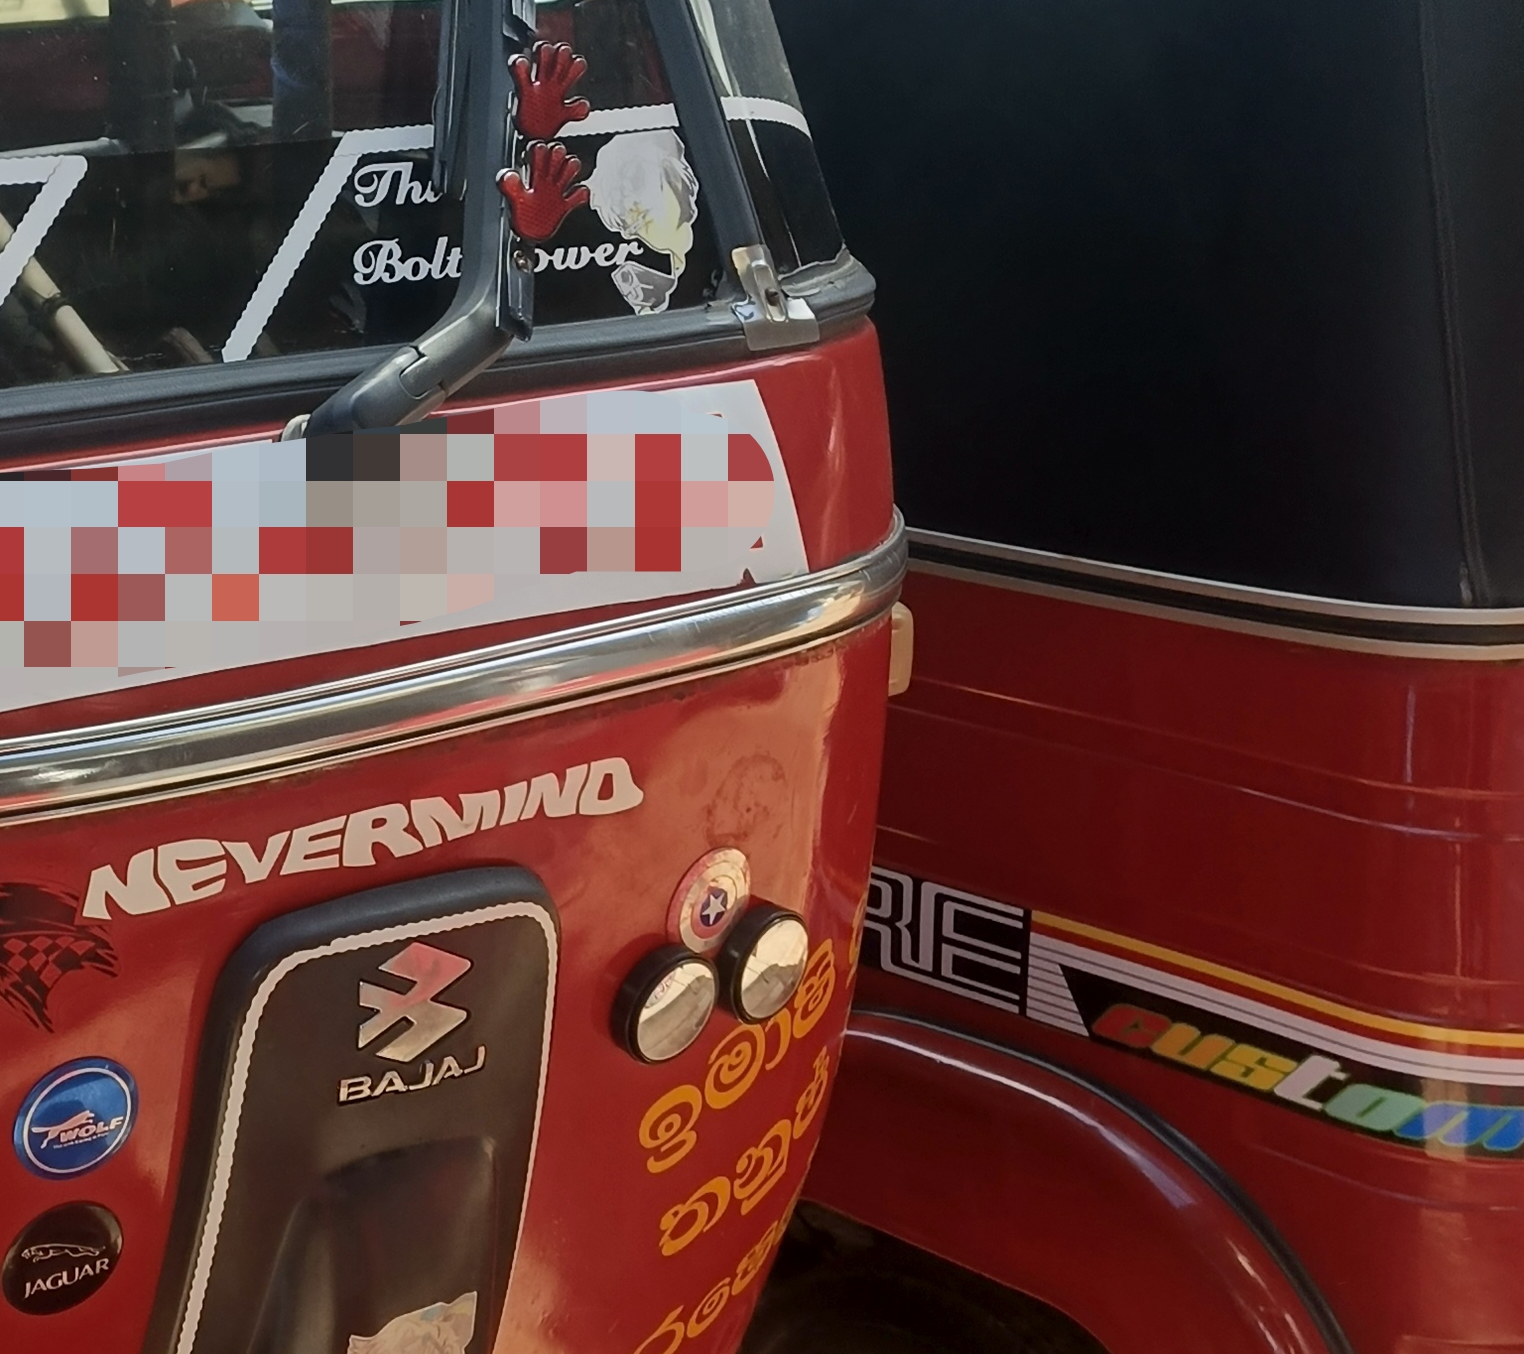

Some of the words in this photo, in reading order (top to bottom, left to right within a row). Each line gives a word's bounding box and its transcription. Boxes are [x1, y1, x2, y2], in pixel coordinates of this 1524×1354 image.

[352, 236, 463, 286] Bolt
[531, 240, 644, 274] ower
[81, 756, 645, 921] NEVERMIND
[338, 1045, 487, 1103] BAJAJ
[59, 1116, 125, 1143] WOLF
[23, 1257, 111, 1299] JAGUAR
